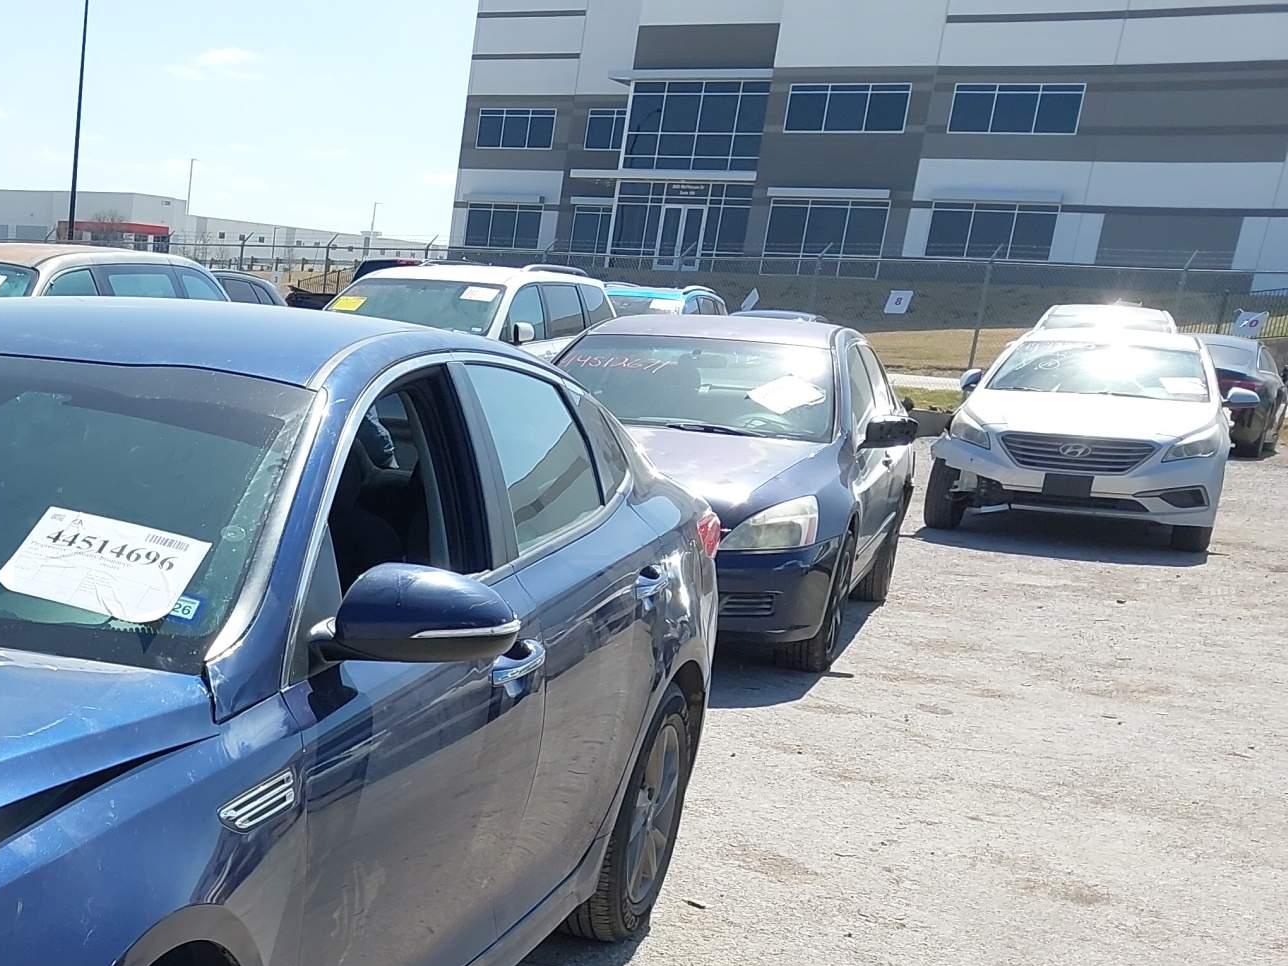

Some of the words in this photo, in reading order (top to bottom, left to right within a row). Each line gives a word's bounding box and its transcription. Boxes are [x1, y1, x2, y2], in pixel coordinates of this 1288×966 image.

[894, 297, 903, 306] 8
[45, 529, 180, 572] 44514696
[172, 602, 193, 616] 26
